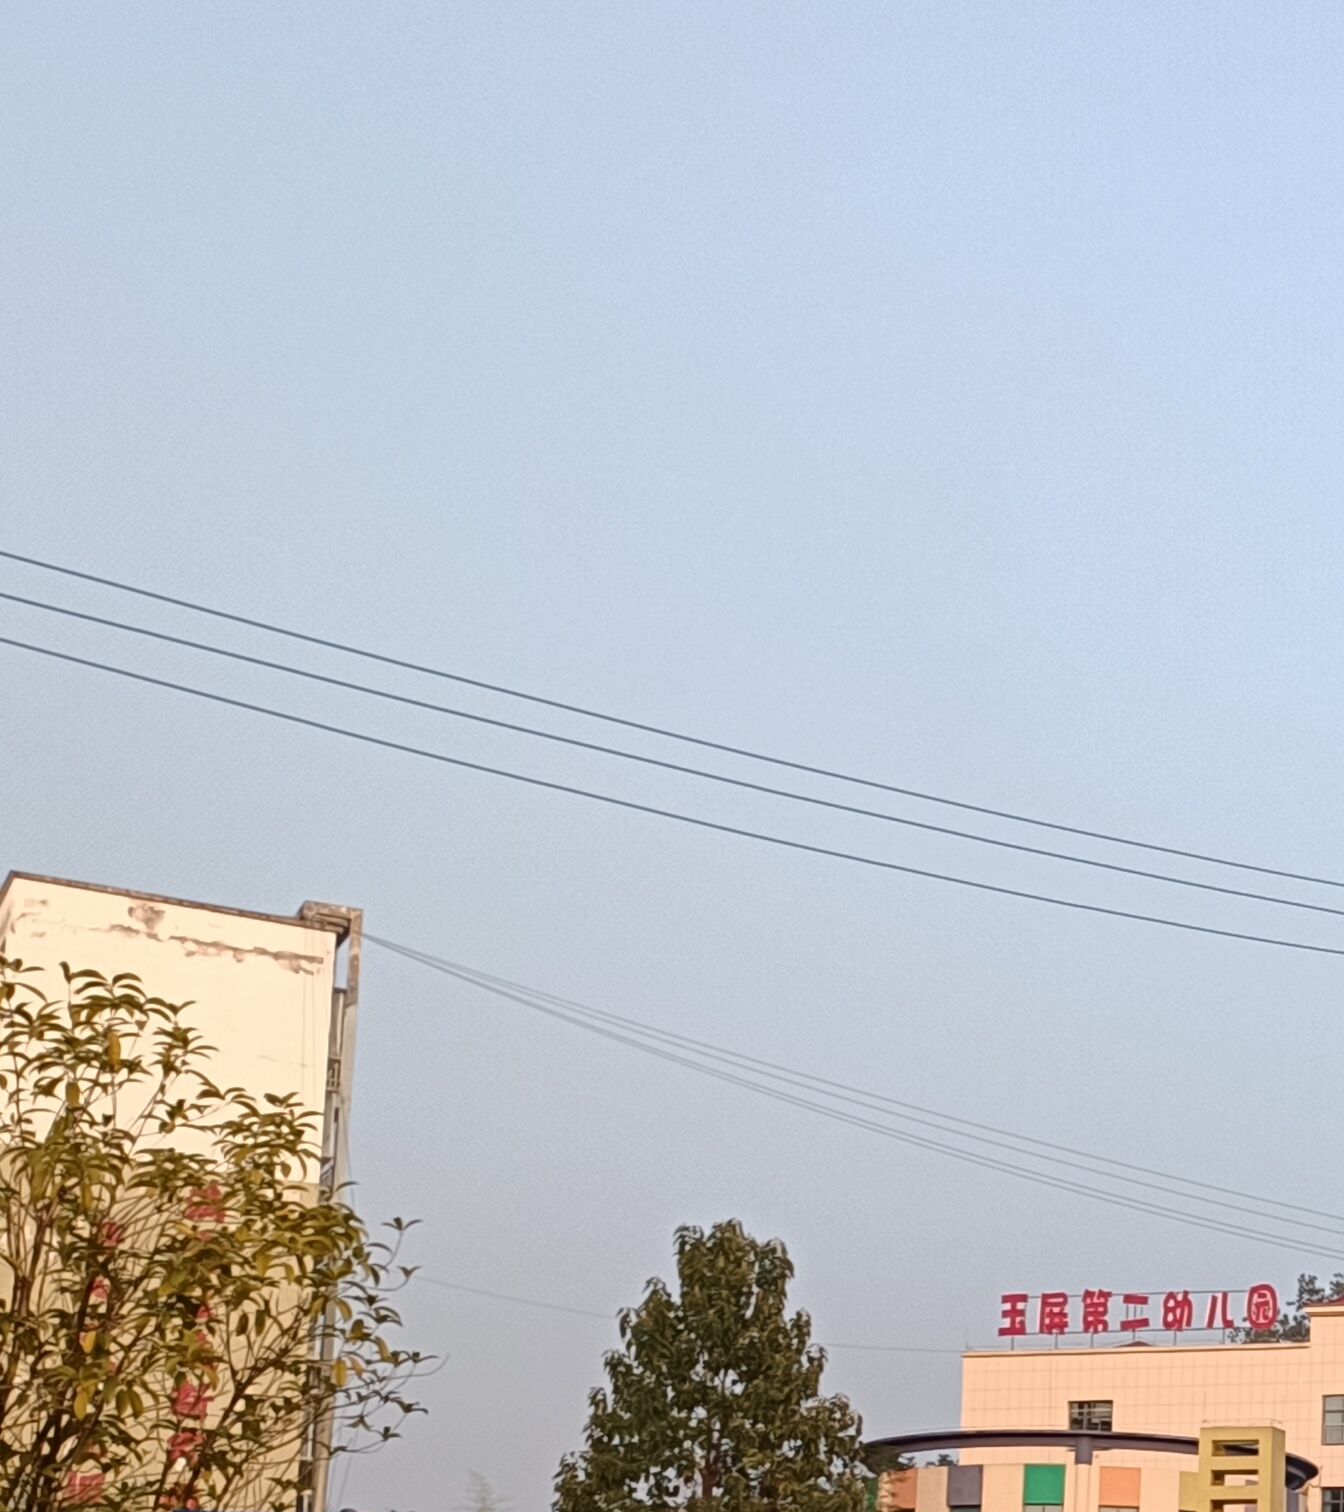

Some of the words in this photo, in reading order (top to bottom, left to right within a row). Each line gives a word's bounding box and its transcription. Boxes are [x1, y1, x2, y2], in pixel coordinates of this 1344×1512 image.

[998, 1283, 1278, 1336] 玉屏第二幼儿园
